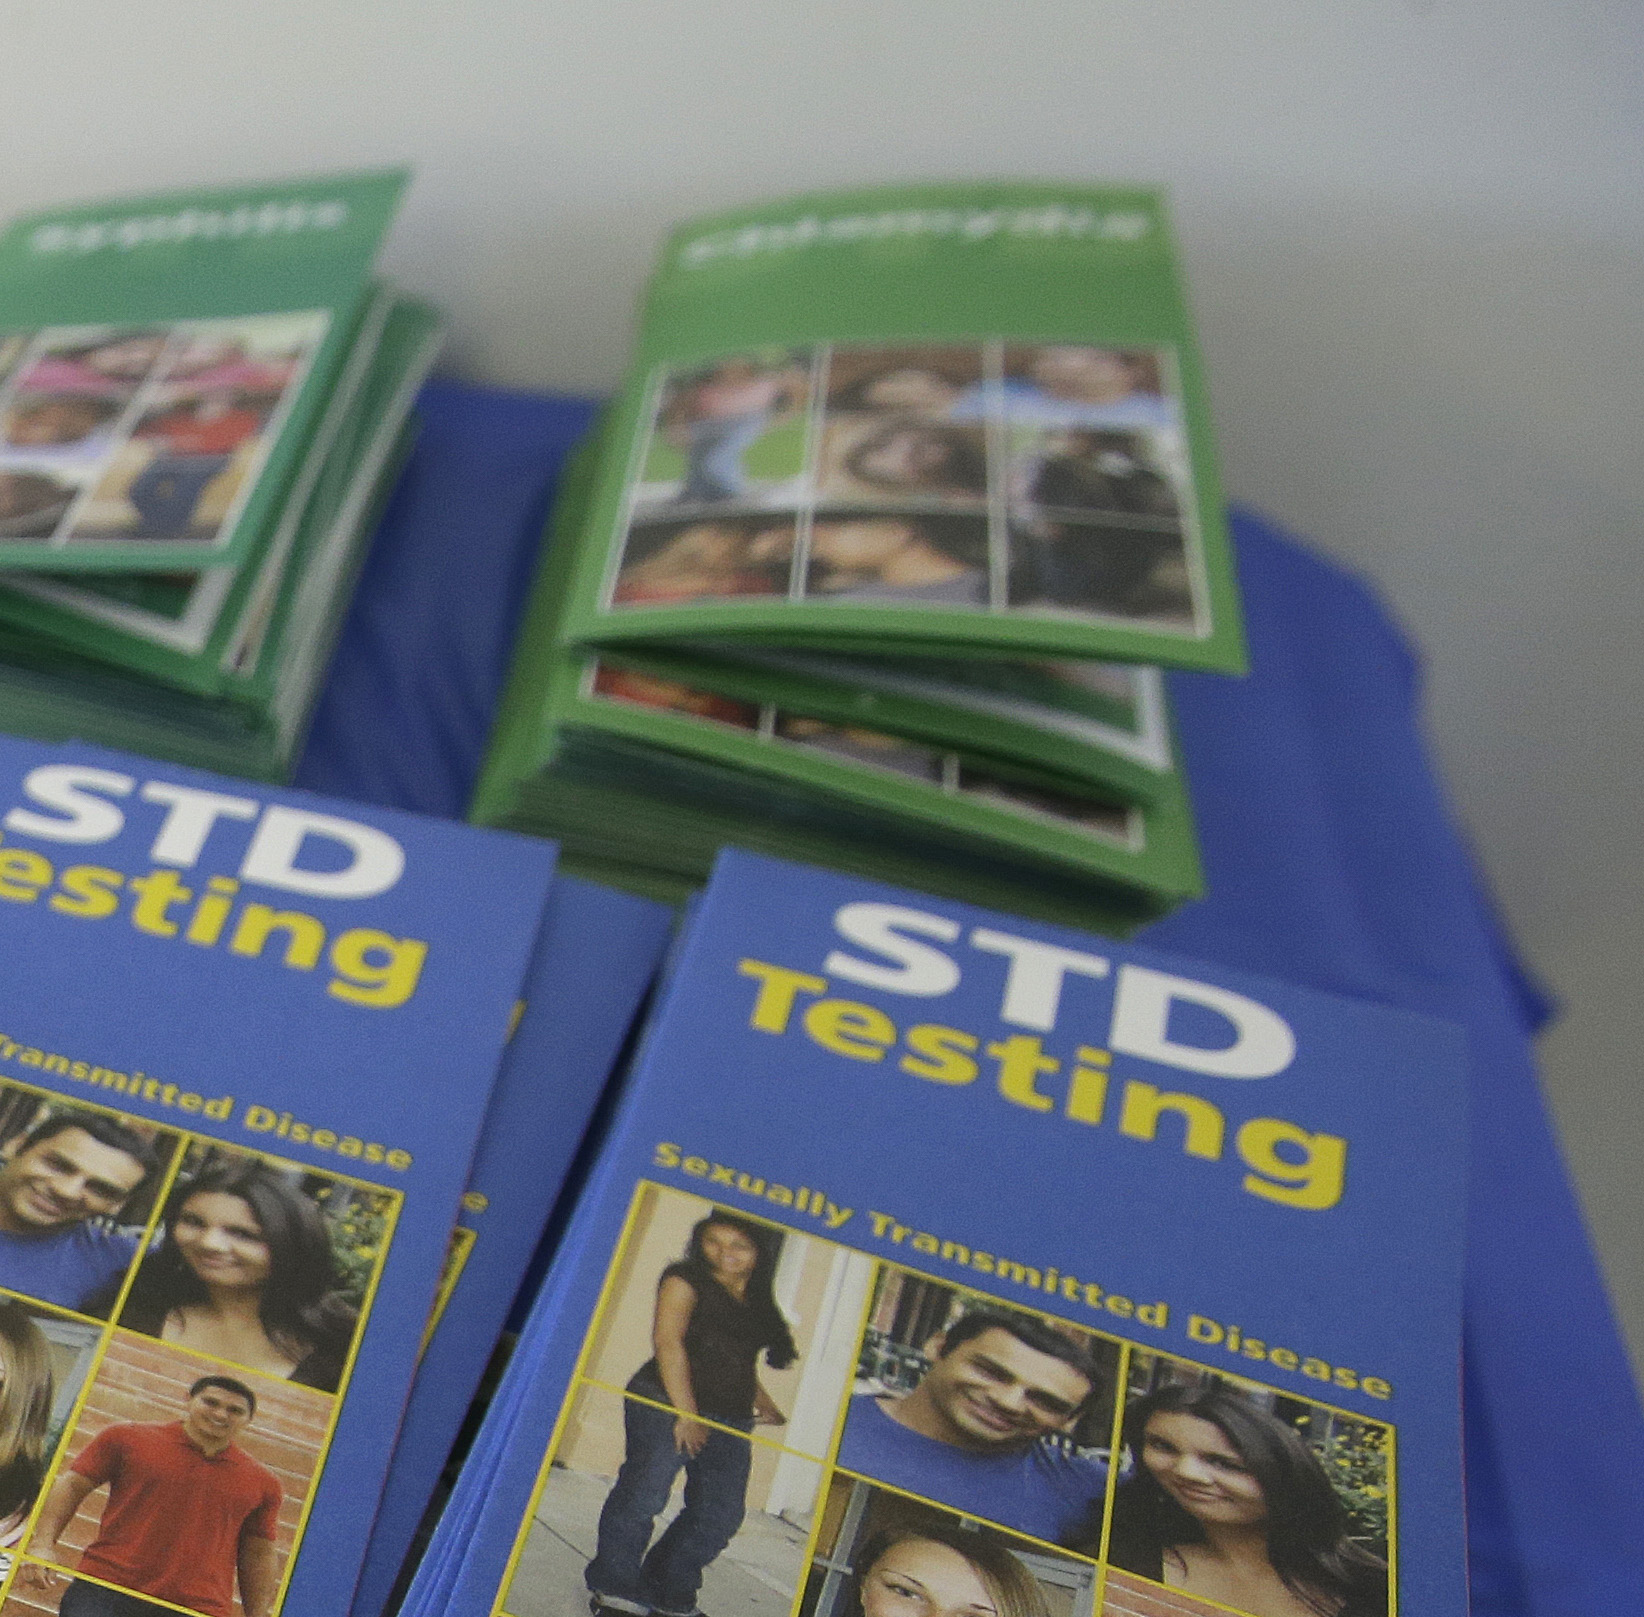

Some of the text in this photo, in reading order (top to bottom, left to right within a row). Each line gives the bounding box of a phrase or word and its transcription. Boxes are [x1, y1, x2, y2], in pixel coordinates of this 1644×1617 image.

[3, 763, 406, 899] STD
[822, 901, 1296, 1080] STD
[243, 1105, 414, 1171] Disease
[738, 958, 1349, 1211] Testing
[653, 1142, 1393, 1401] Sexually Transmitted Disease
